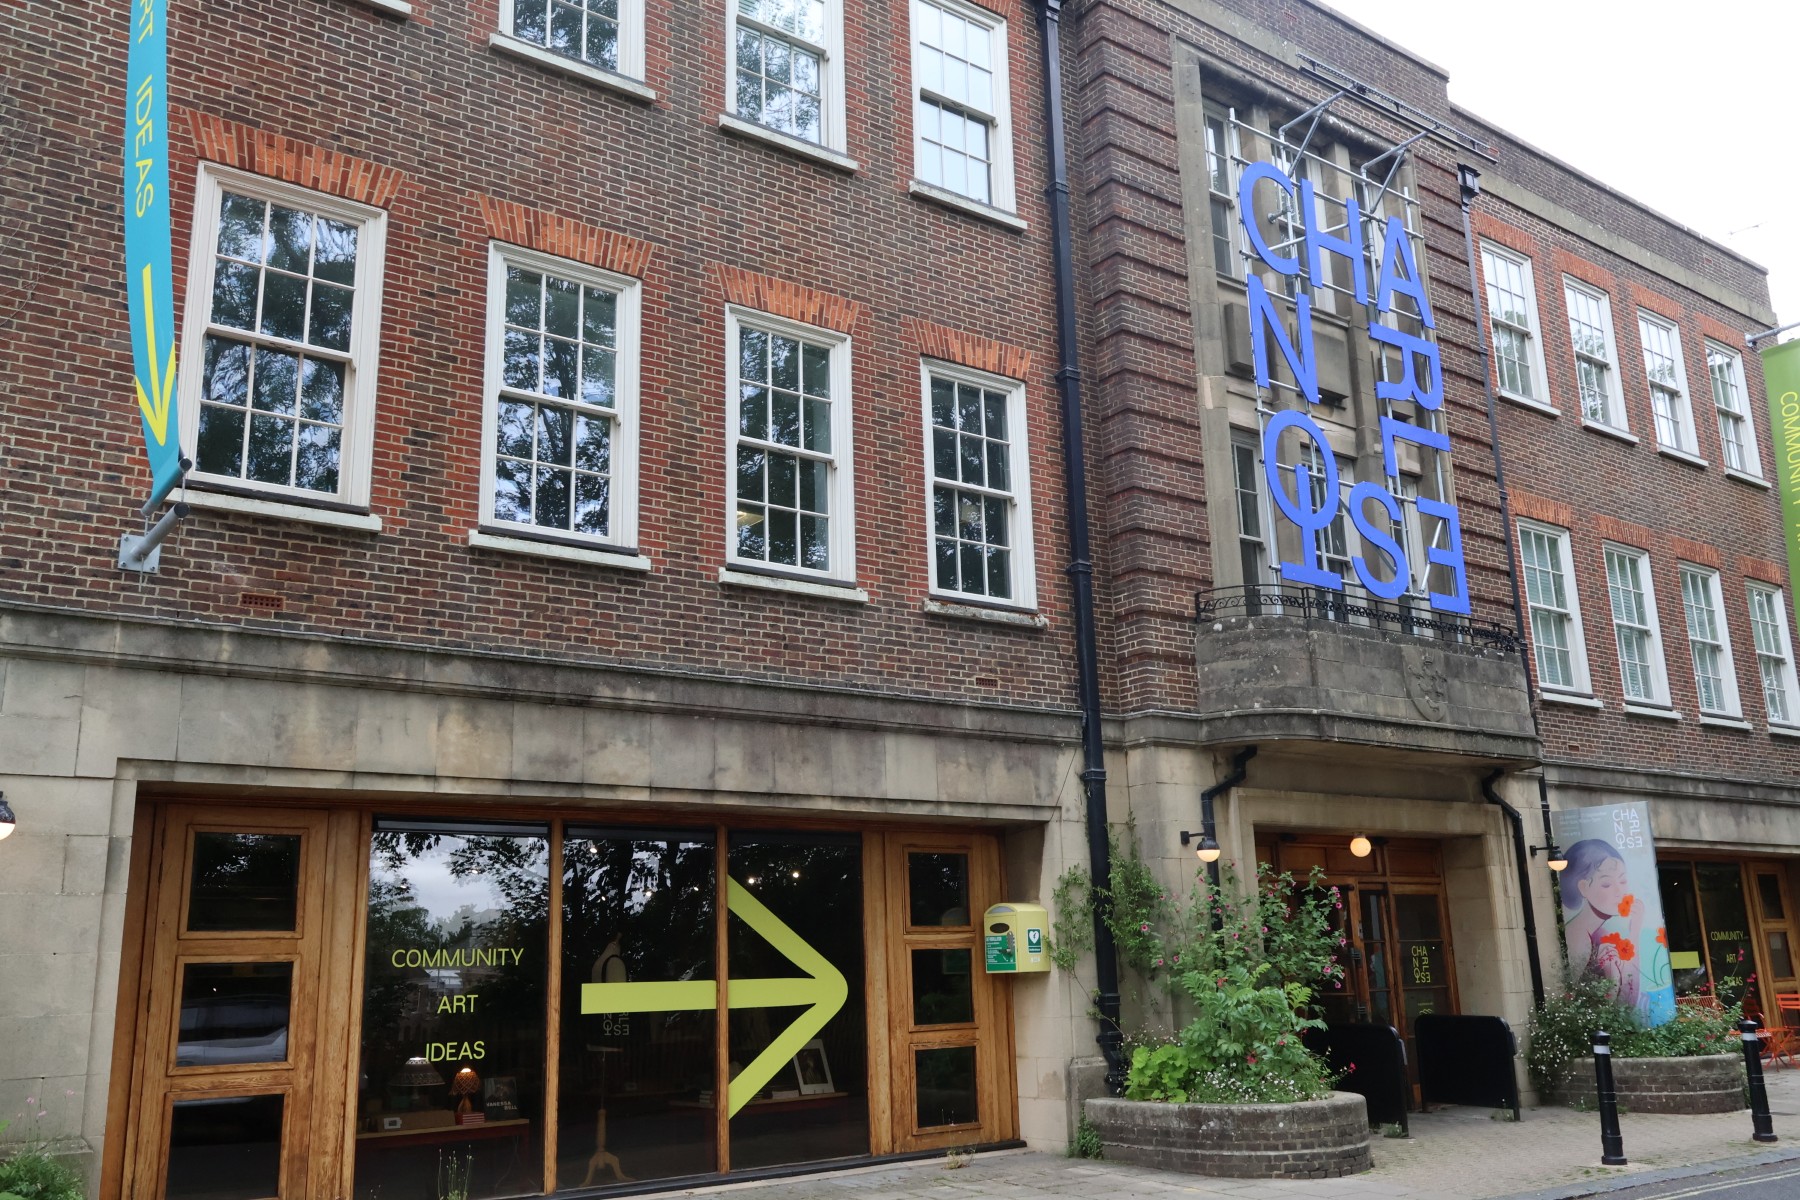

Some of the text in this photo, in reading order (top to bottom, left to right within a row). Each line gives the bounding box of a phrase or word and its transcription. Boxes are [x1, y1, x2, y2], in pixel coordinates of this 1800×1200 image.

[136, 0, 153, 218] RT IDEAS
[1711, 931, 1744, 940] COMMUNITY
[391, 948, 524, 968] COMMUNITY
[1726, 953, 1737, 963] ART
[436, 994, 478, 1014] ART
[425, 1040, 485, 1062] IDEAS
